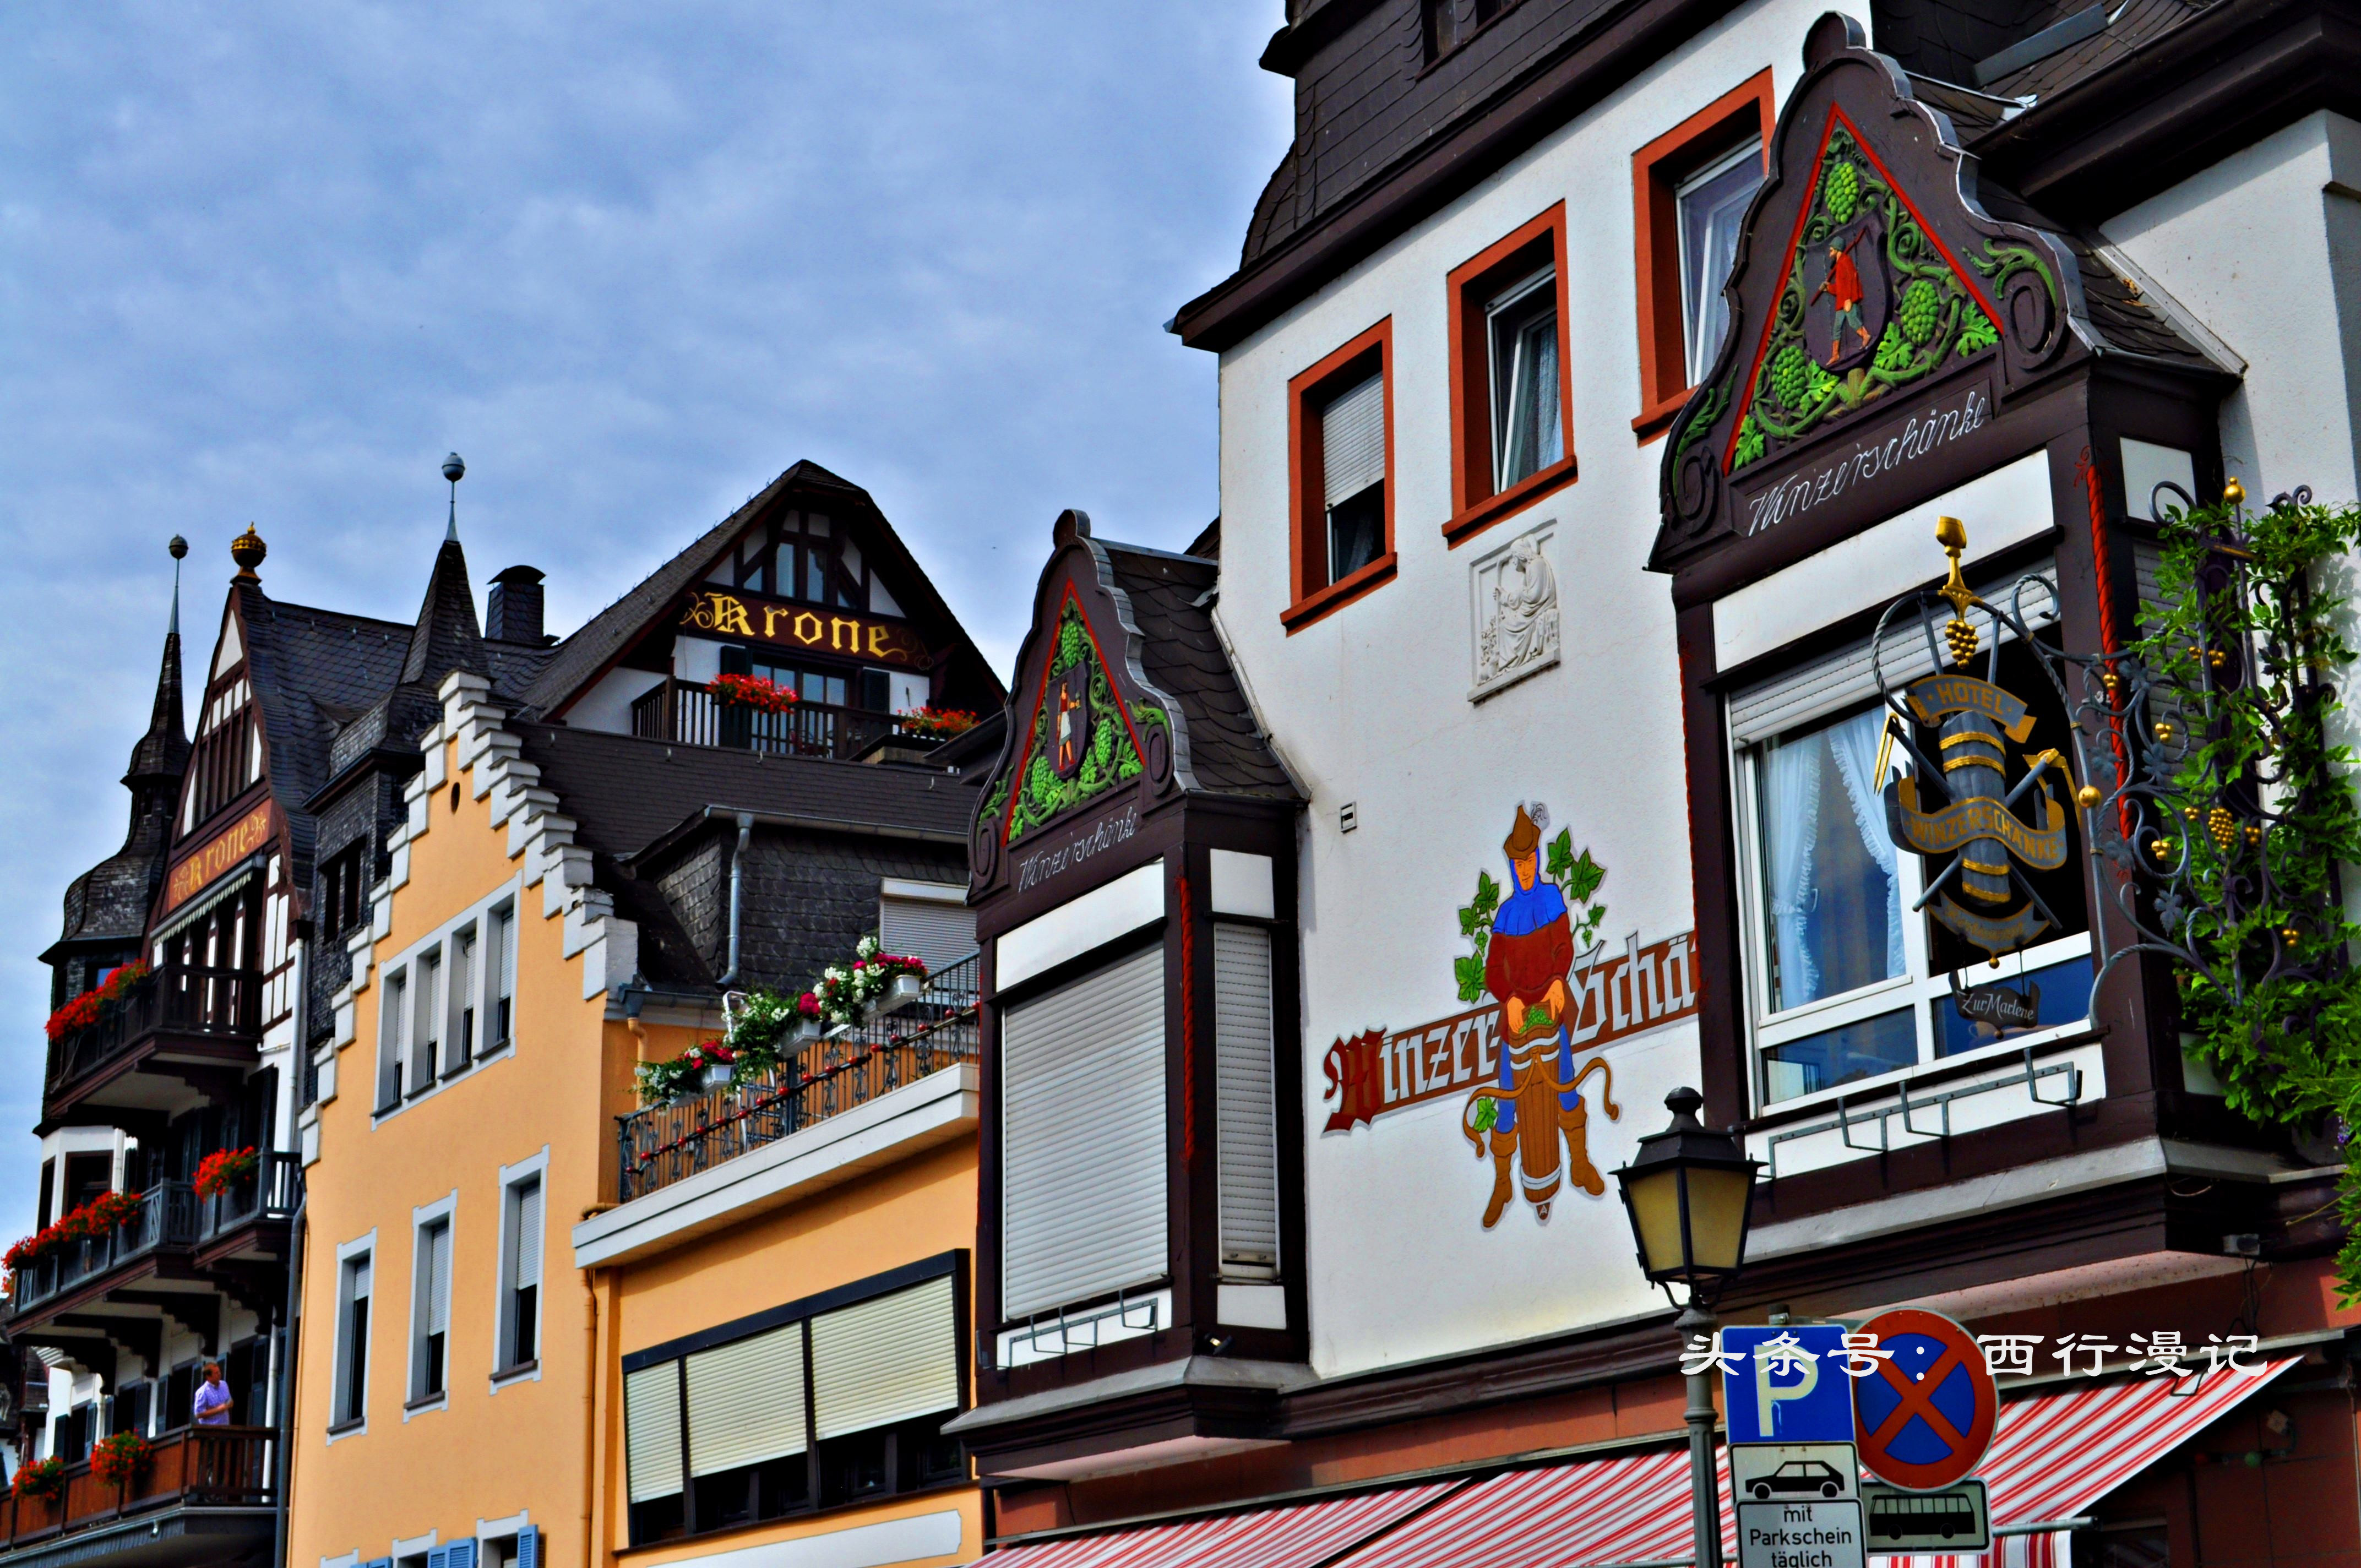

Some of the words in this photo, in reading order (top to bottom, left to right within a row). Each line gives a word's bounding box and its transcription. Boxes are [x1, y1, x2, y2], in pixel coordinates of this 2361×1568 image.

[704, 592, 907, 657] Krone
[1936, 682, 2004, 715] HOTEL
[189, 821, 249, 891] Krone
[1956, 990, 1987, 1015] Zur
[1984, 993, 2034, 1020] Marlene
[1754, 1344, 1818, 1437] P
[1783, 1505, 1813, 1522] mit
[1750, 1527, 1852, 1546] Parkschein
[1771, 1550, 1832, 1568] täglich
